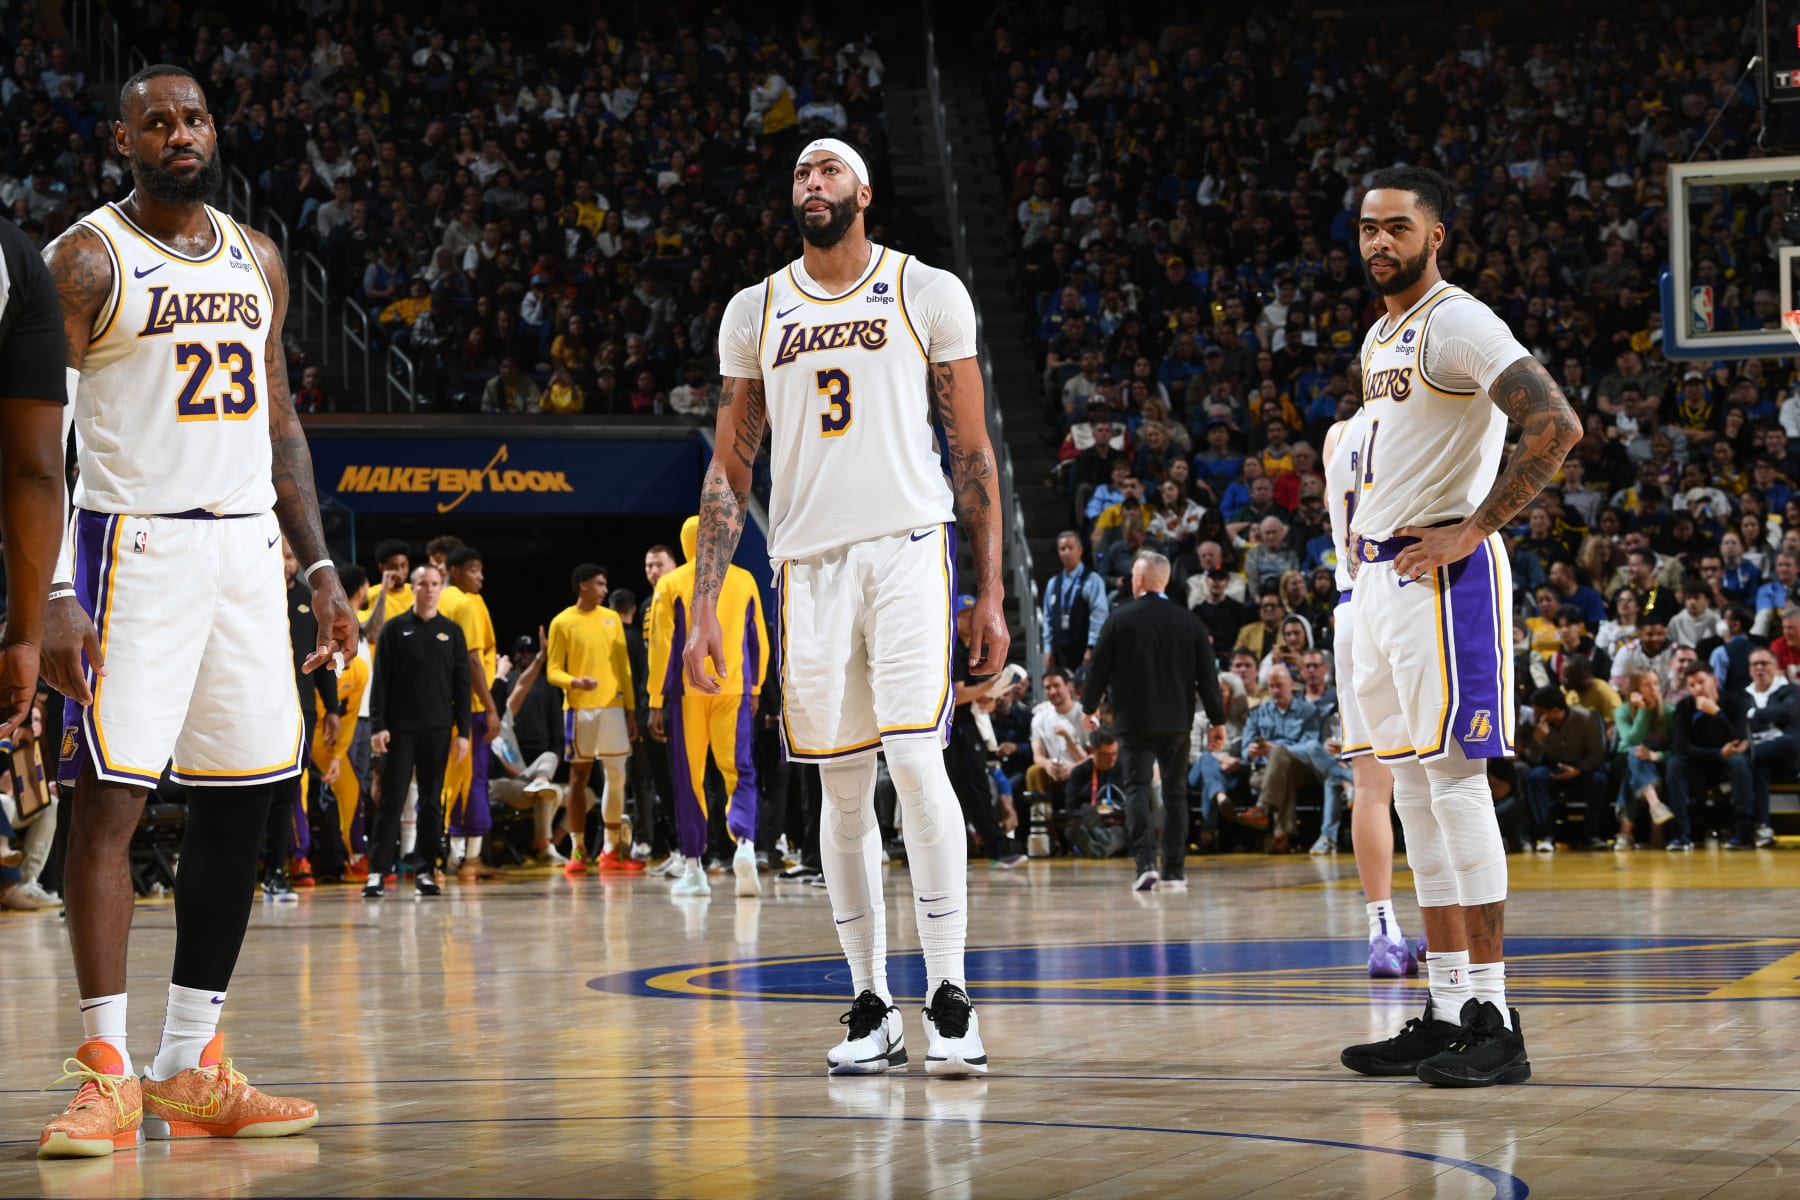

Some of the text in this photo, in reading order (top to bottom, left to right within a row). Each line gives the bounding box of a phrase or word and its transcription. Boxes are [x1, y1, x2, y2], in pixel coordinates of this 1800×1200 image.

[229, 260, 253, 272] bibigo
[136, 285, 262, 339] LAKERS
[866, 296, 894, 305] bibigo
[772, 318, 889, 370] LAKERS
[1395, 345, 1415, 356] bibigo
[174, 340, 258, 422] 23
[815, 367, 853, 438] 3
[1363, 366, 1415, 403] AKERS
[1364, 418, 1380, 489] 1
[489, 469, 574, 492] LOOK
